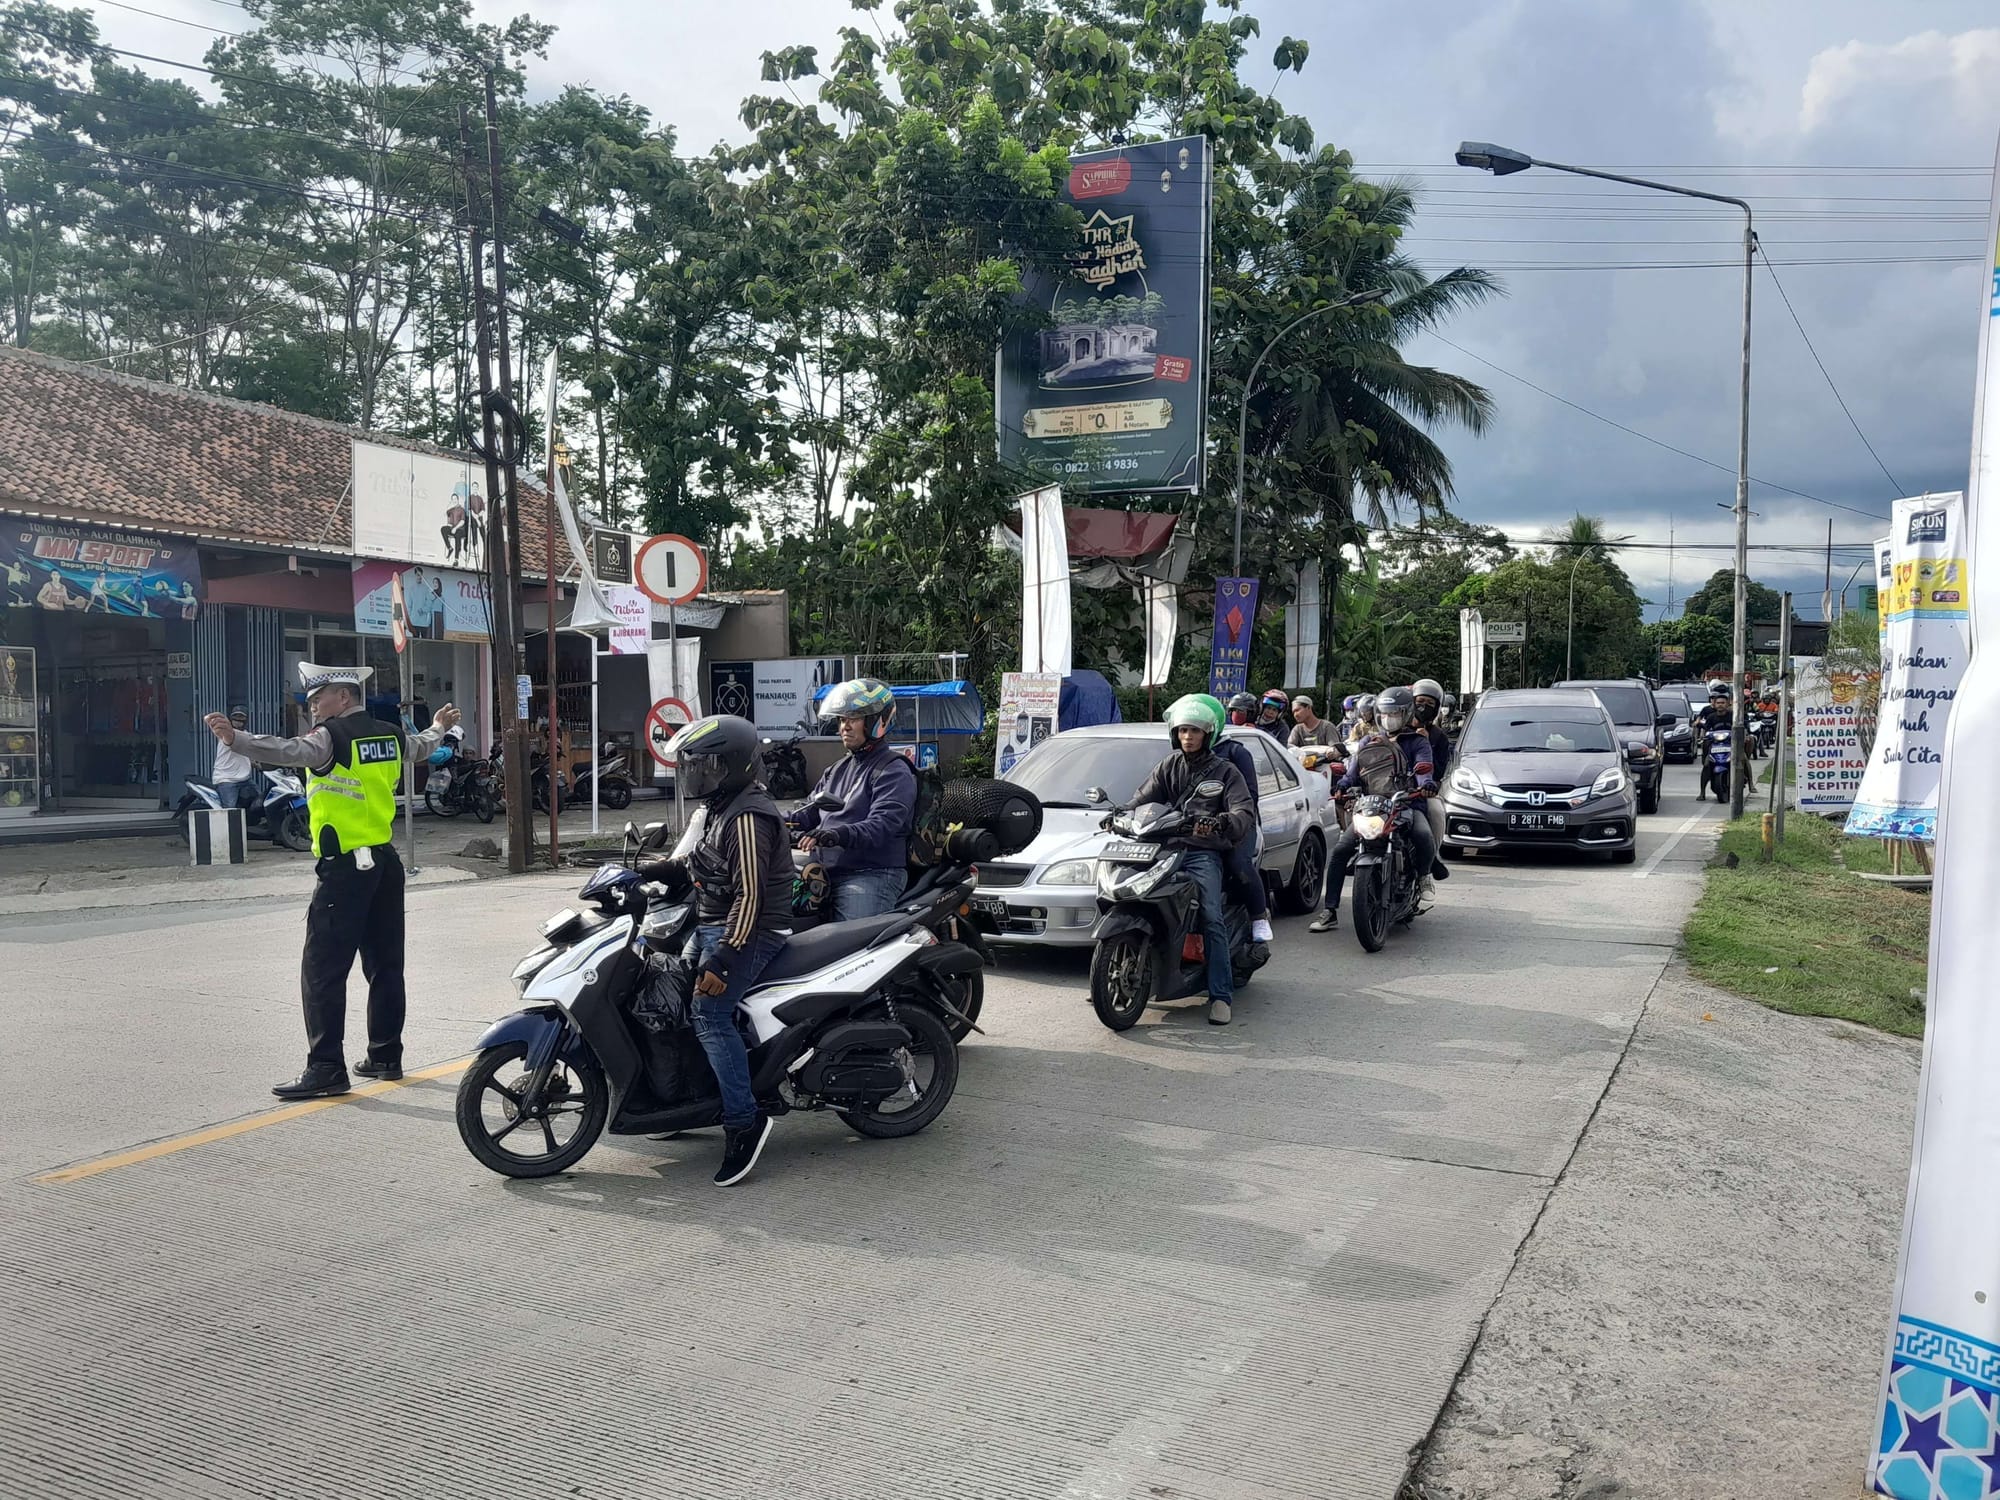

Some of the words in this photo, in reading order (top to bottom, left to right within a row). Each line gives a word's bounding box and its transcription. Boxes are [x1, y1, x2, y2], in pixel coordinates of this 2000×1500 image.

[1082, 226, 1113, 245] THR
[1163, 359, 1185, 369] Gratis
[1160, 366, 1168, 376] 2
[1114, 459, 1139, 469] 9836
[57, 527, 80, 537] ALAT
[115, 532, 163, 548] OLAHRAGA
[34, 535, 79, 560] MM
[78, 540, 156, 569] SPORT
[60, 561, 85, 571] Depan
[613, 605, 646, 615] Nibras
[612, 628, 647, 638] AJIBARANG
[1488, 624, 1514, 632] POLISI
[1219, 647, 1225, 659] 1
[755, 692, 797, 702] THANIAQUE
[1806, 706, 1854, 716] BAKSO
[1806, 717, 1836, 727] AYAM
[1806, 729, 1834, 738] IKAN
[1806, 738, 1857, 748] UDANG
[1807, 750, 1844, 759] CUMI
[1907, 746, 1941, 764] Cita
[1807, 760, 1836, 769] SOP
[1840, 759, 1866, 768] IKA
[1807, 771, 1836, 780] SOP
[1511, 815, 1517, 824] B
[1521, 814, 1541, 825] 2871
[1547, 815, 1565, 825] FMB
[834, 959, 875, 982] GEAR
